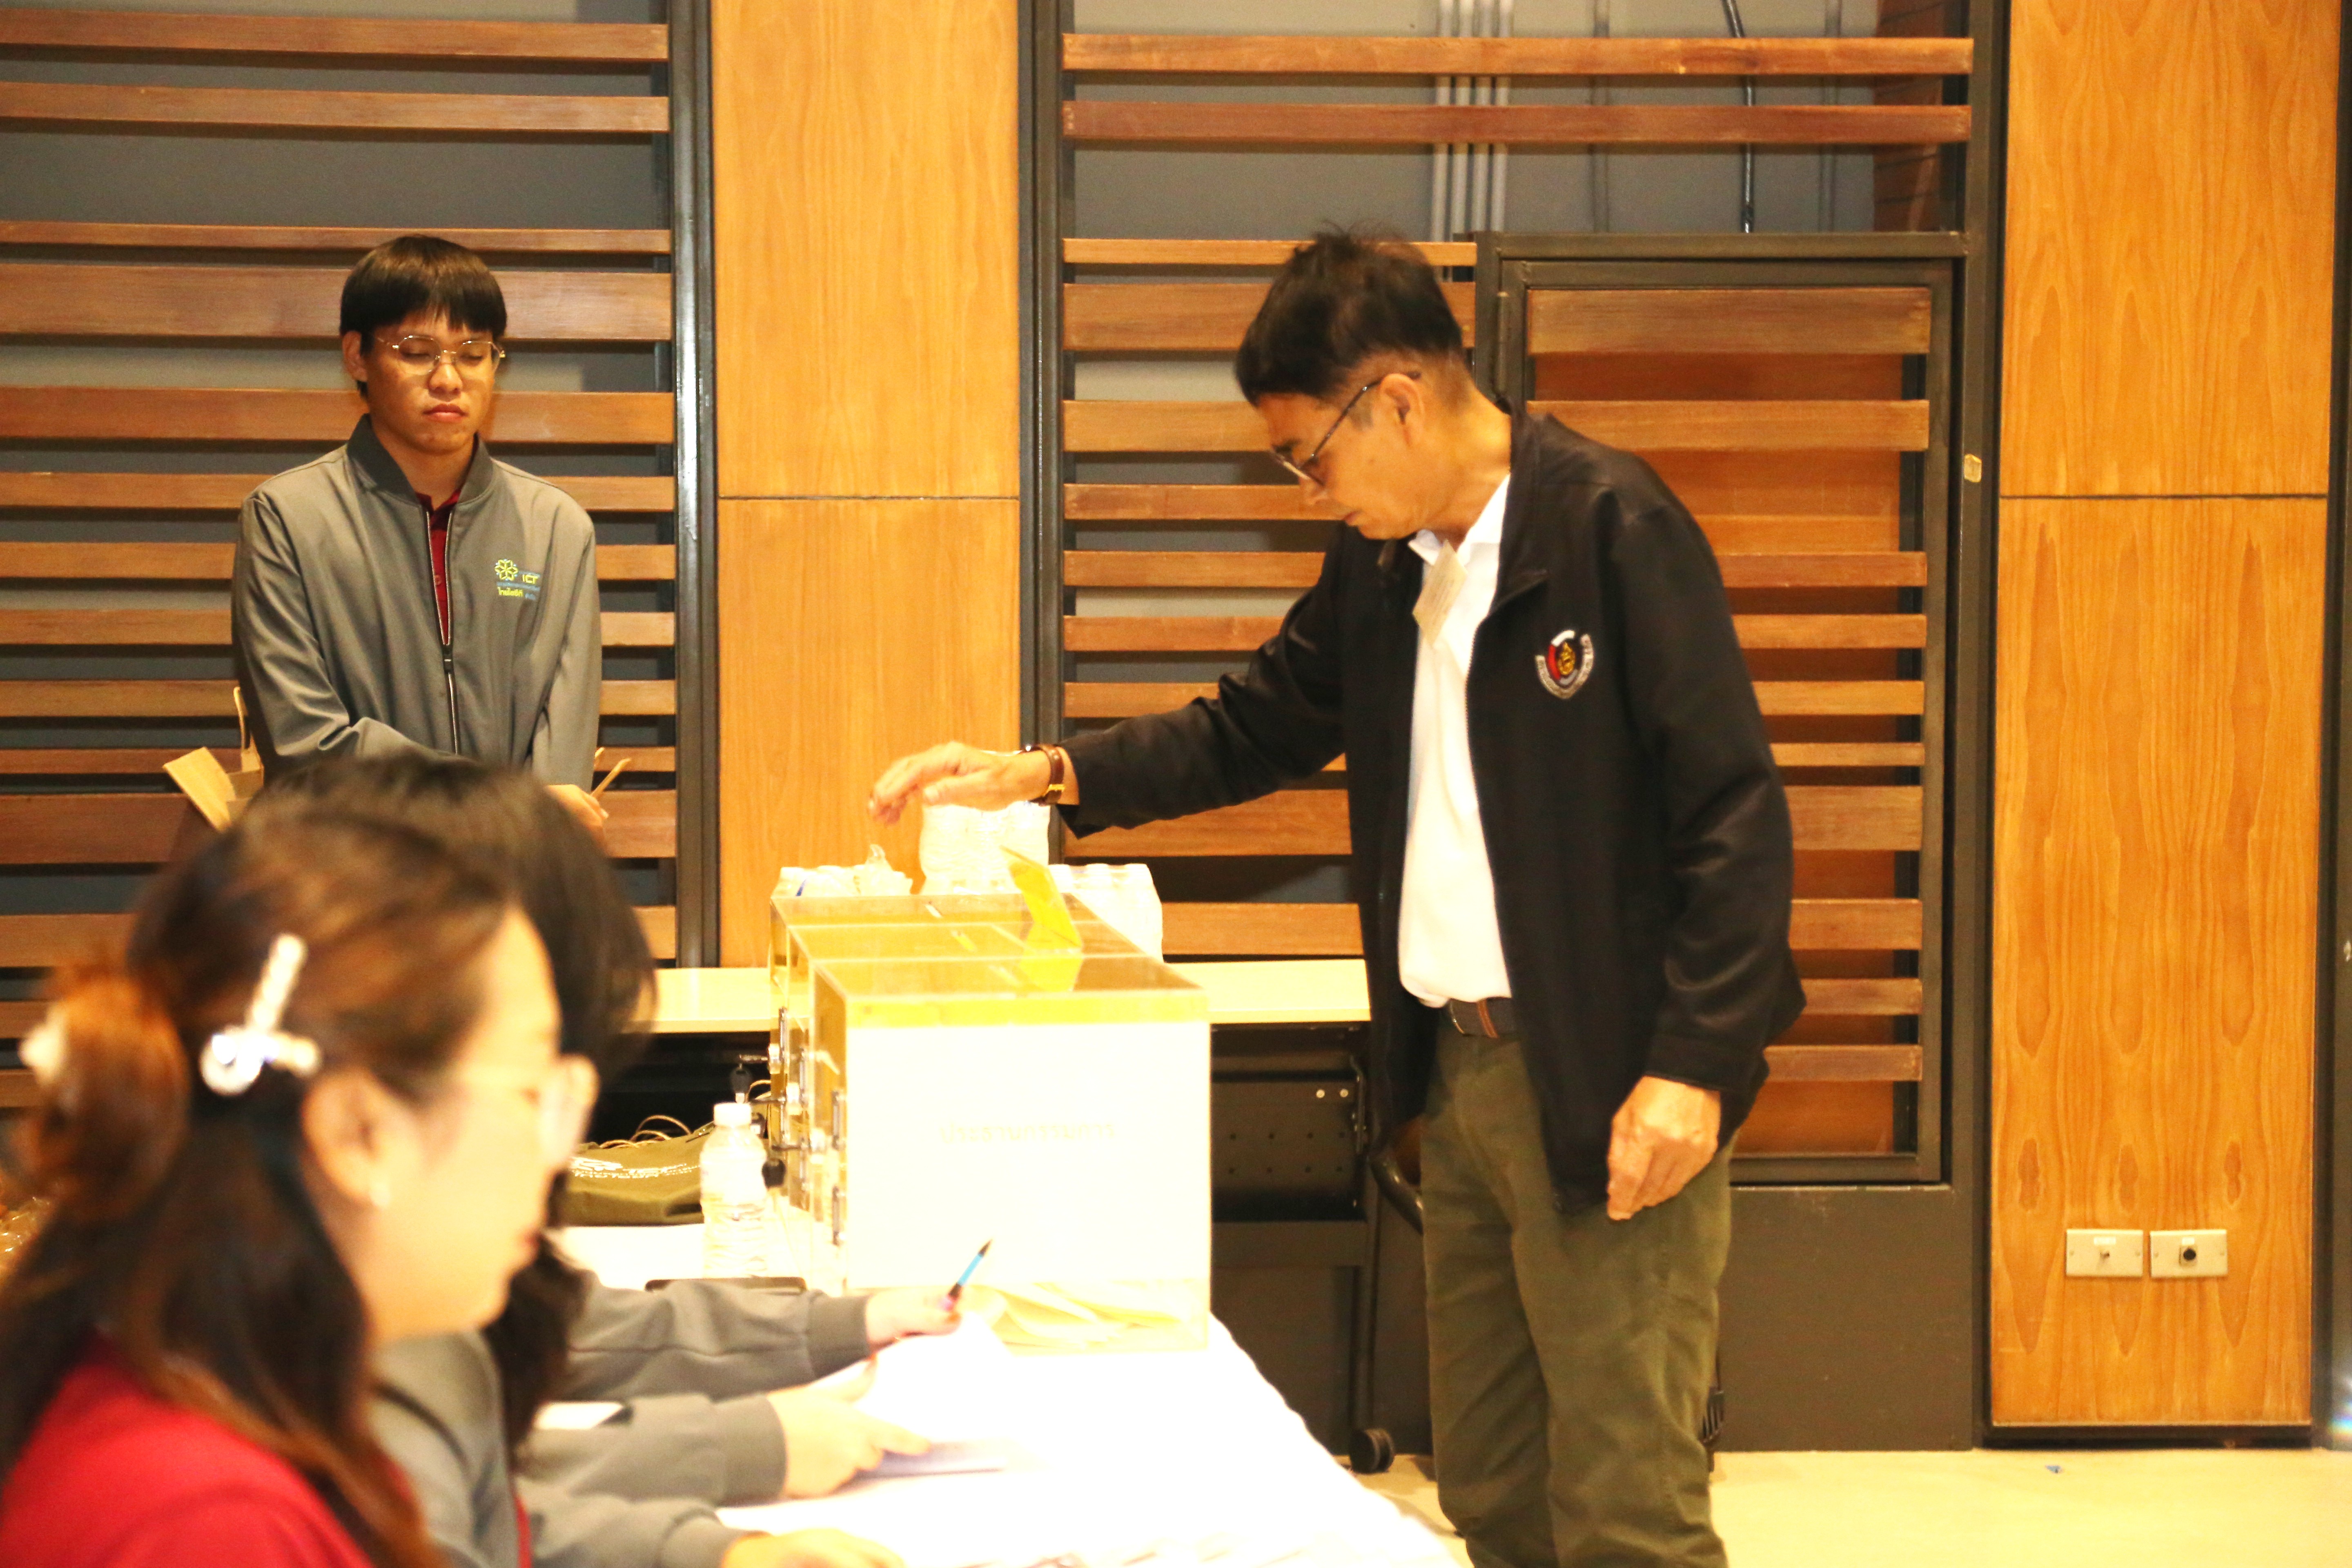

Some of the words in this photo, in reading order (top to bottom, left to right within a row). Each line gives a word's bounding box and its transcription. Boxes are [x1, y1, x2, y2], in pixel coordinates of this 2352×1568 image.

[940, 1120, 1115, 1143] ประธานกรรมการ
